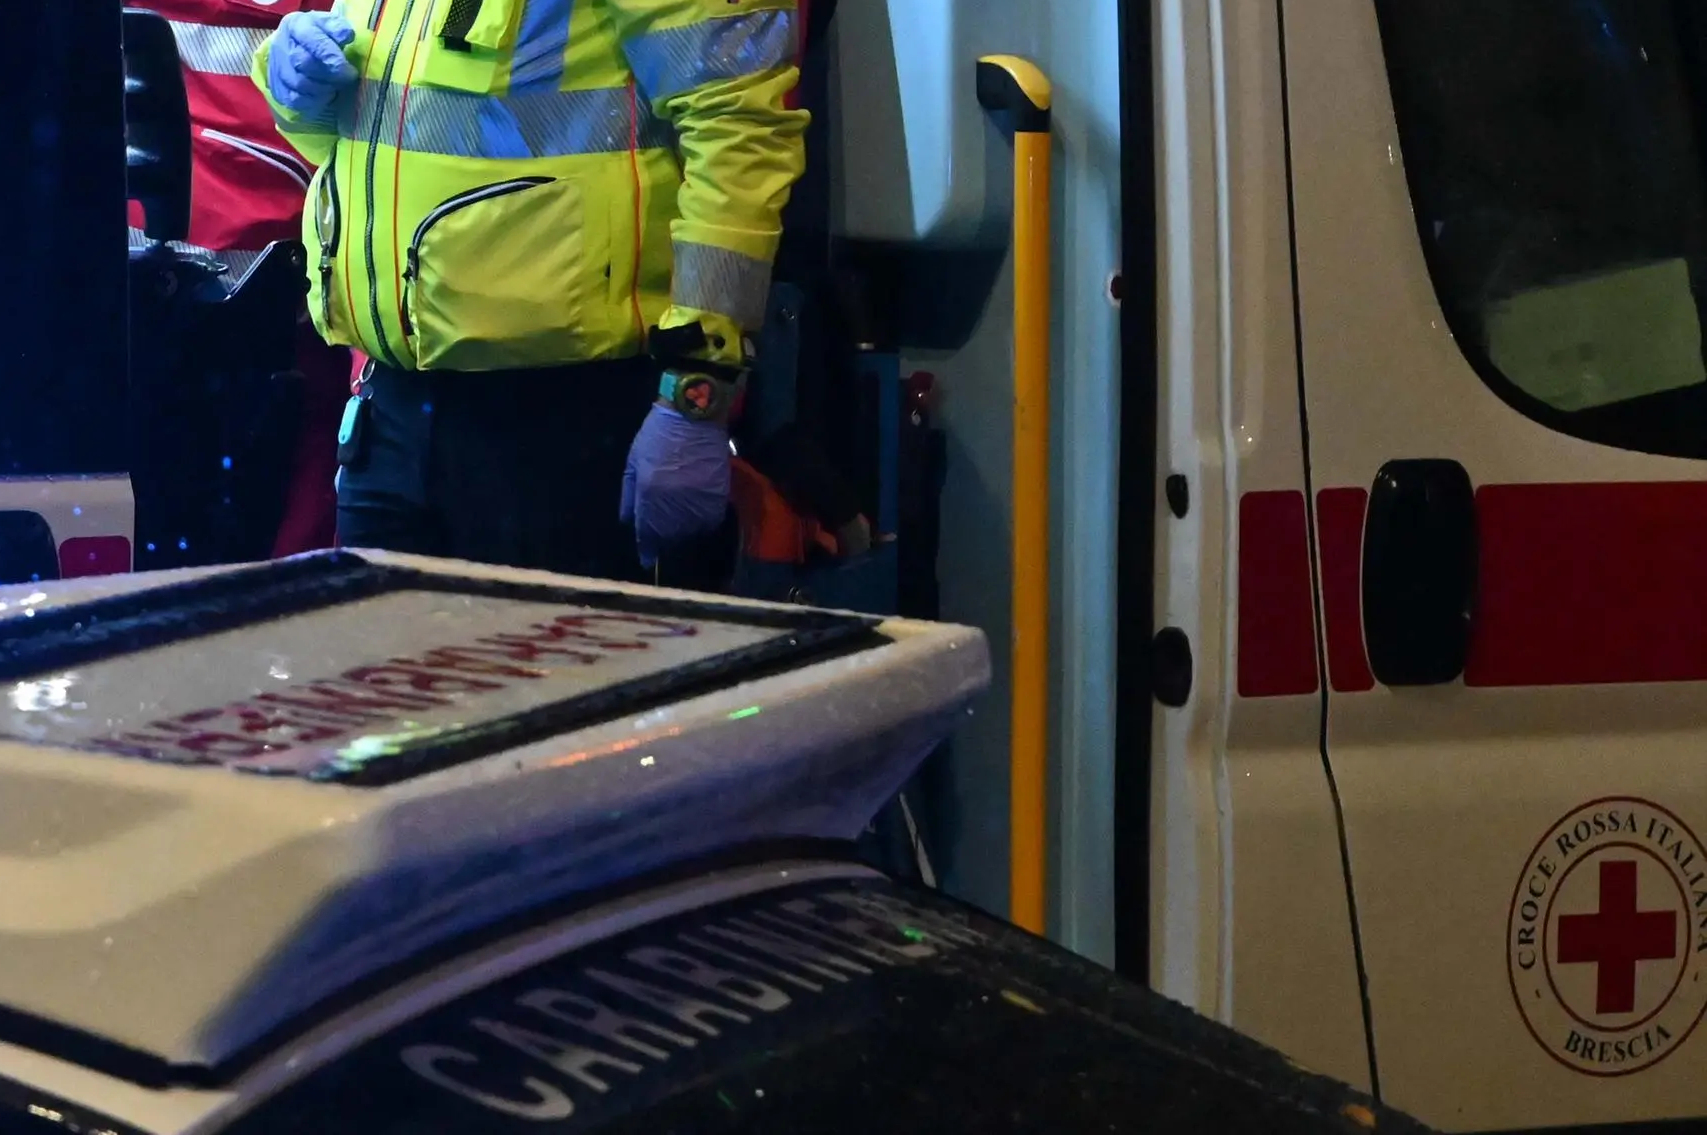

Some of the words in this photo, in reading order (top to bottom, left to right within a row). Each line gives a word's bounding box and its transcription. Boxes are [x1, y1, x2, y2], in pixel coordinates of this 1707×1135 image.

[1518, 855, 1557, 970] CROCE
[1555, 810, 1638, 857] ROSSA
[1564, 1024, 1672, 1063] BRESCIA
